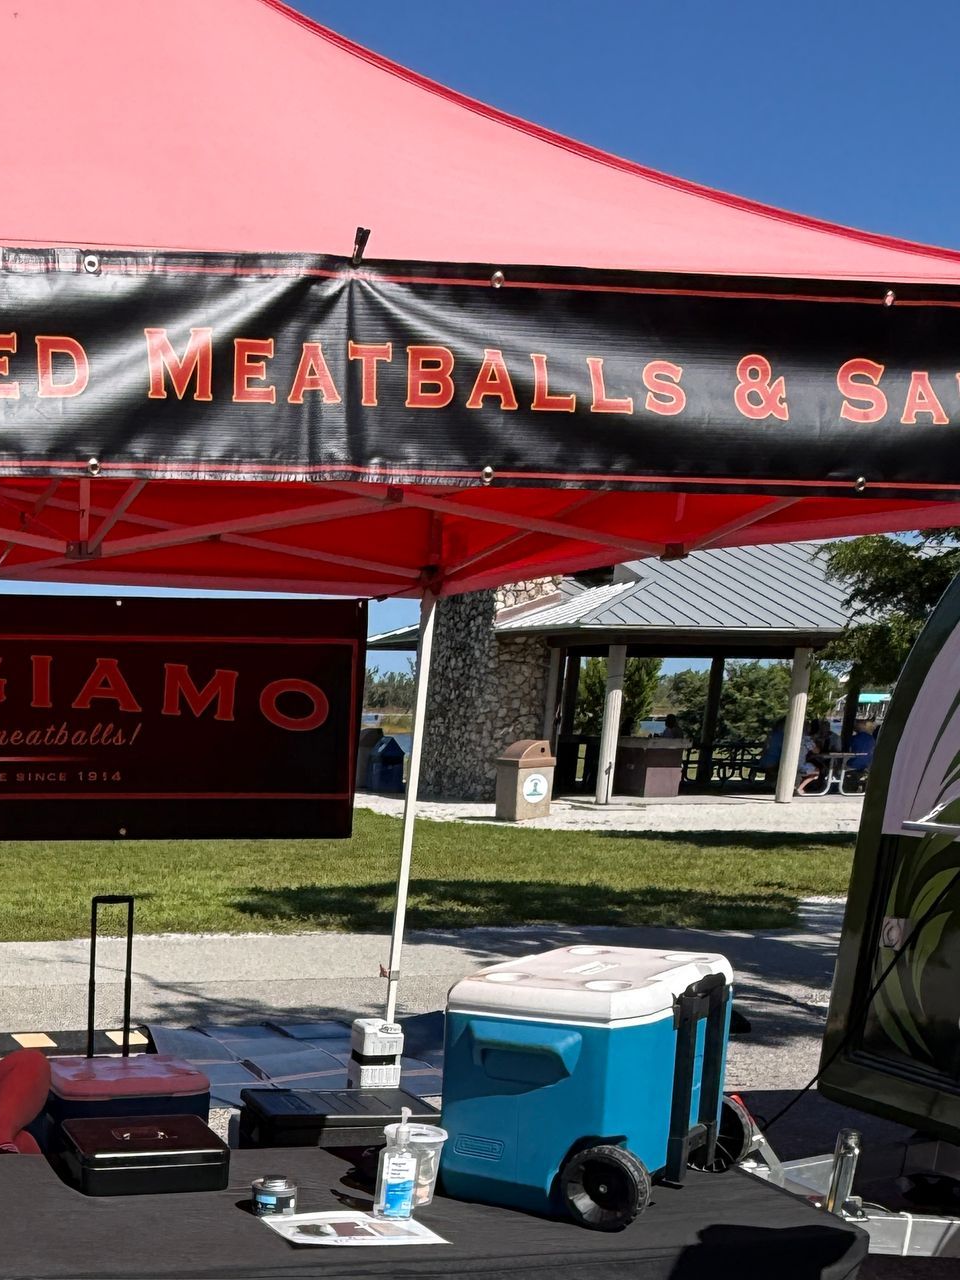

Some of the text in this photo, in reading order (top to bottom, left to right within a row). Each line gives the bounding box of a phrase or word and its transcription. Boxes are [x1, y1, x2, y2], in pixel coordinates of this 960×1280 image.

[143, 326, 687, 418] MEATBALLS
[733, 353, 790, 422] &
[836, 357, 960, 426] SA
[16, 771, 67, 782] SINCE
[78, 770, 122, 781] 1914
